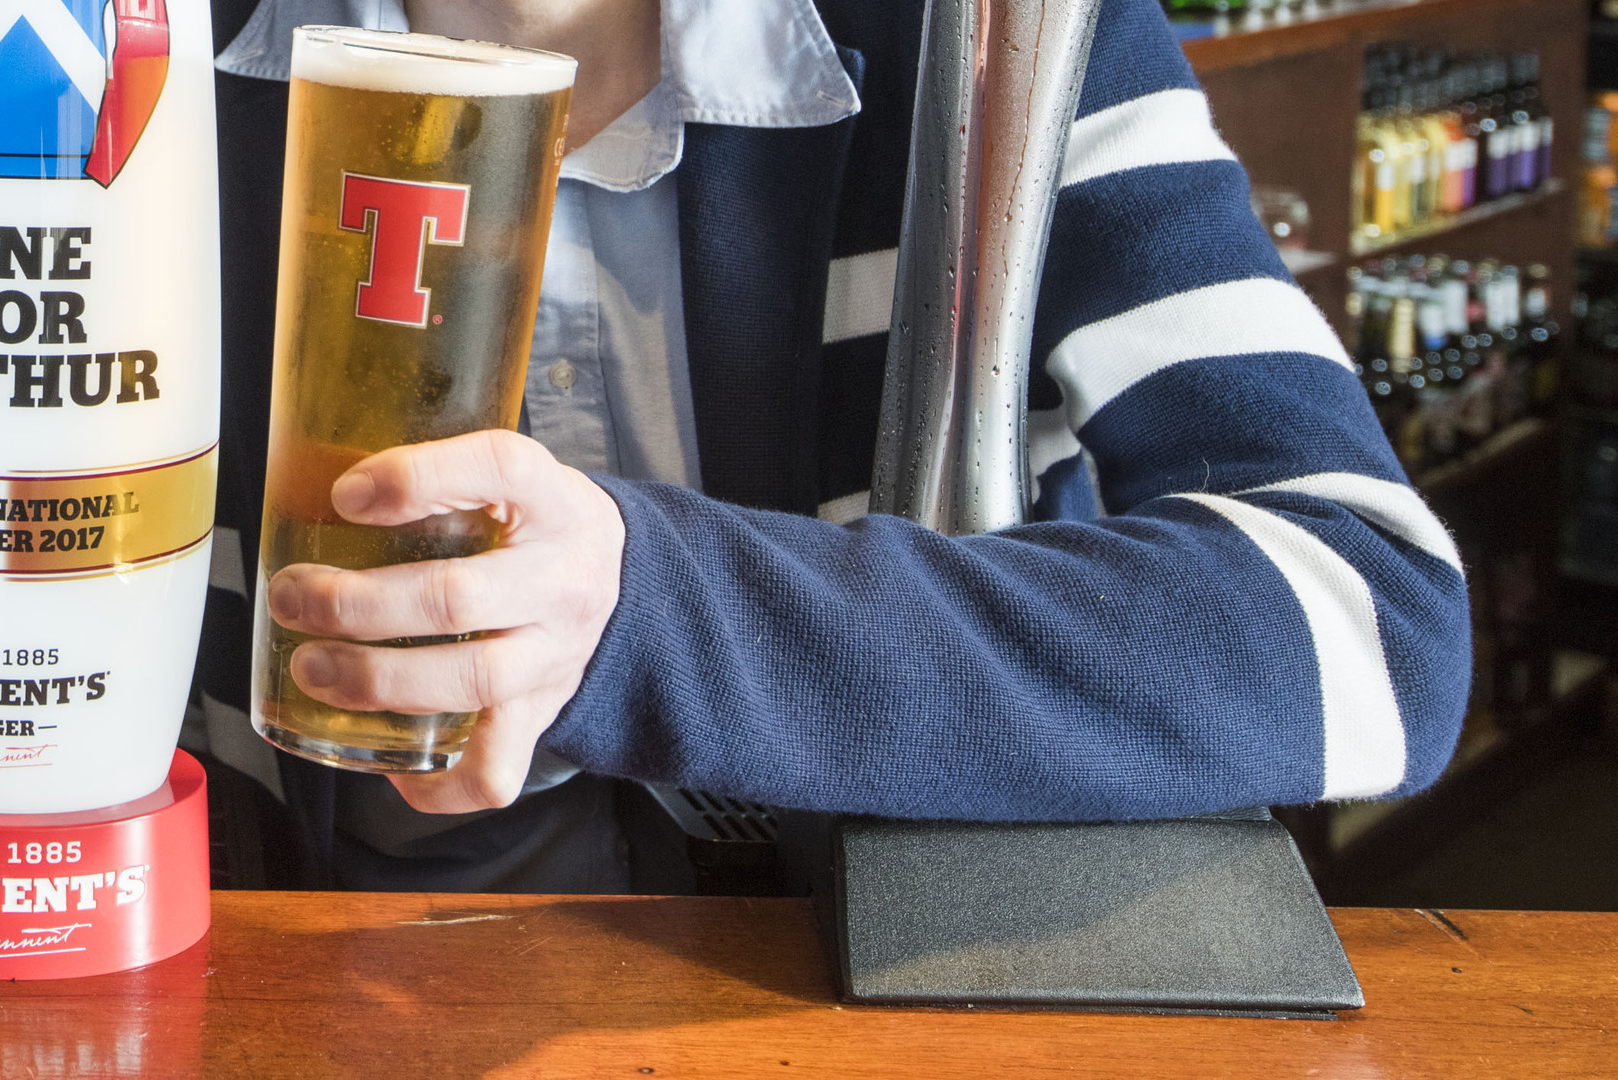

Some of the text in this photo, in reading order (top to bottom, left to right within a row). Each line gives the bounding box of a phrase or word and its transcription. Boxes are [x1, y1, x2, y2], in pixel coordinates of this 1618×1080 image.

[339, 171, 472, 330] T
[38, 525, 107, 553] 2017
[2, 648, 60, 666] 1885
[6, 840, 82, 864] 1885
